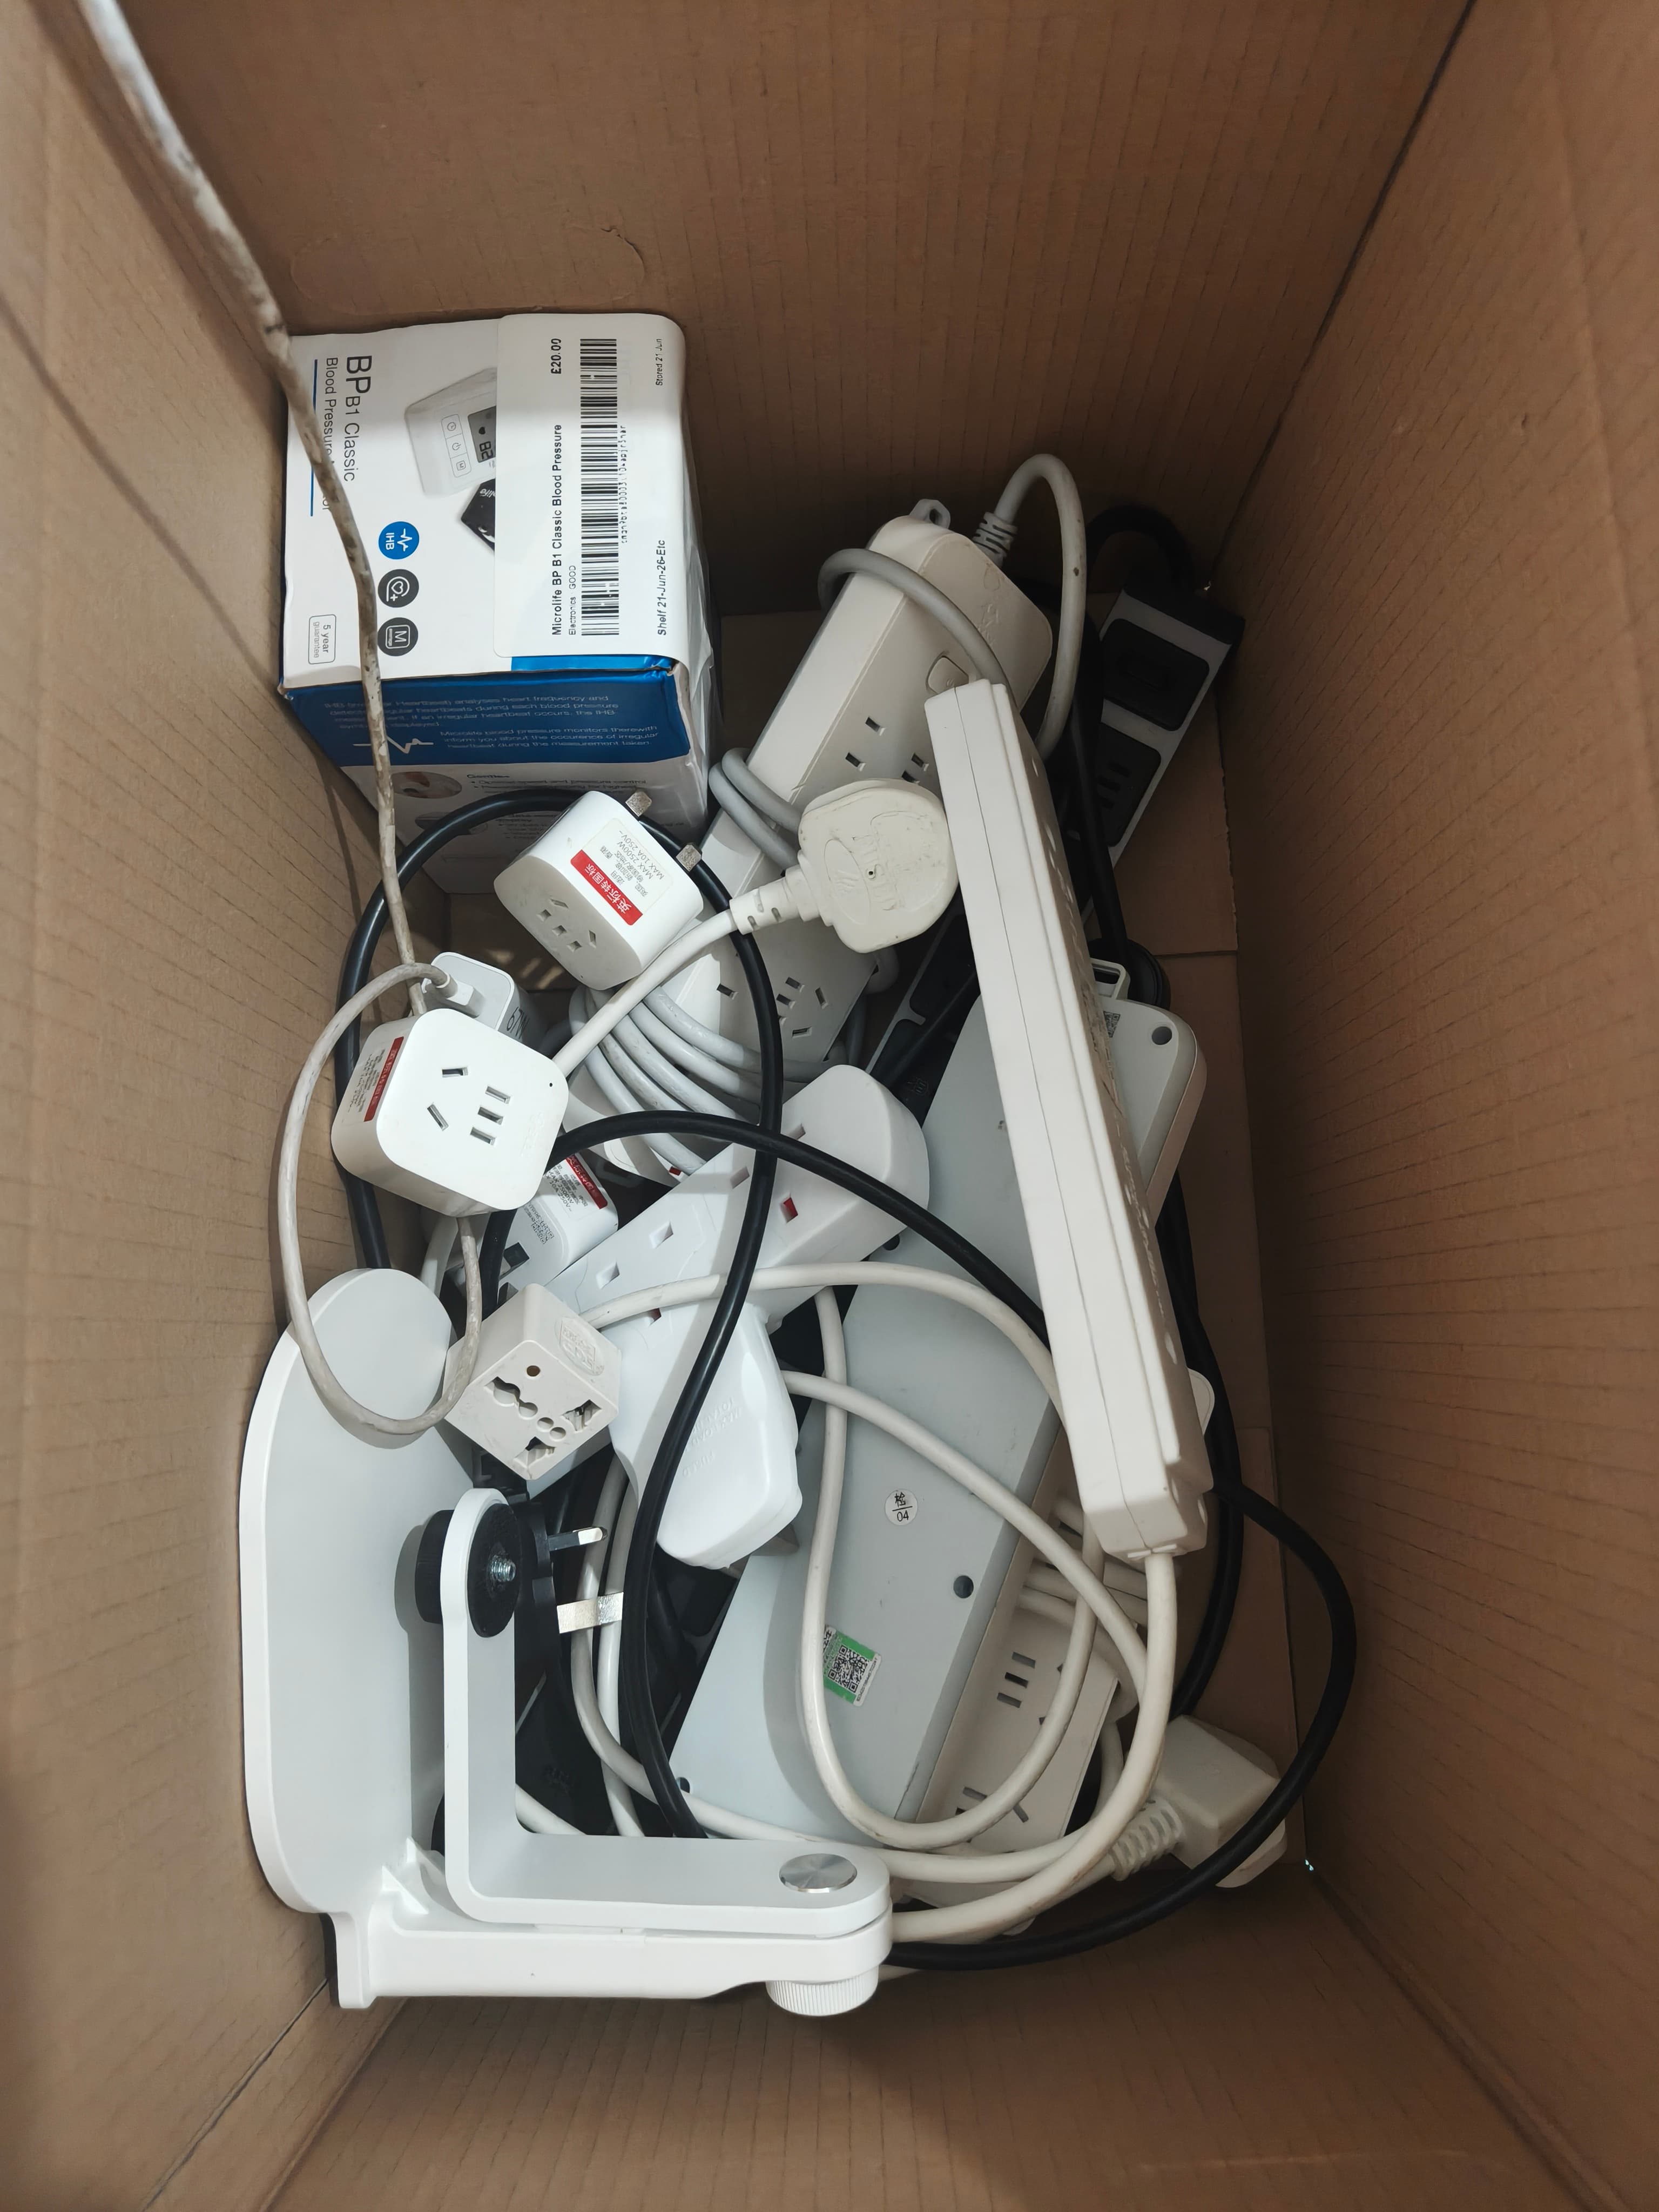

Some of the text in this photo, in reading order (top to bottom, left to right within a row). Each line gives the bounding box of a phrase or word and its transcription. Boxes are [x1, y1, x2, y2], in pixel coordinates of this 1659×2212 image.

[551, 339, 561, 374] £20.00
[655, 353, 663, 361] 21
[326, 358, 338, 394] Blood
[655, 363, 664, 386] Stored
[344, 355, 372, 482] BP B1 Classic
[386, 532, 394, 550] IHB
[552, 425, 562, 636] Microlife BP B1 Classic Blood Pressure
[657, 610, 667, 636] Shelf
[321, 633, 329, 652] year
[617, 841, 653, 879] MAX 2500W
[638, 850, 649, 864] 10A
[649, 863, 664, 880] MAX
[584, 863, 632, 914] 英标转国标
[896, 1509, 909, 1522] 04
